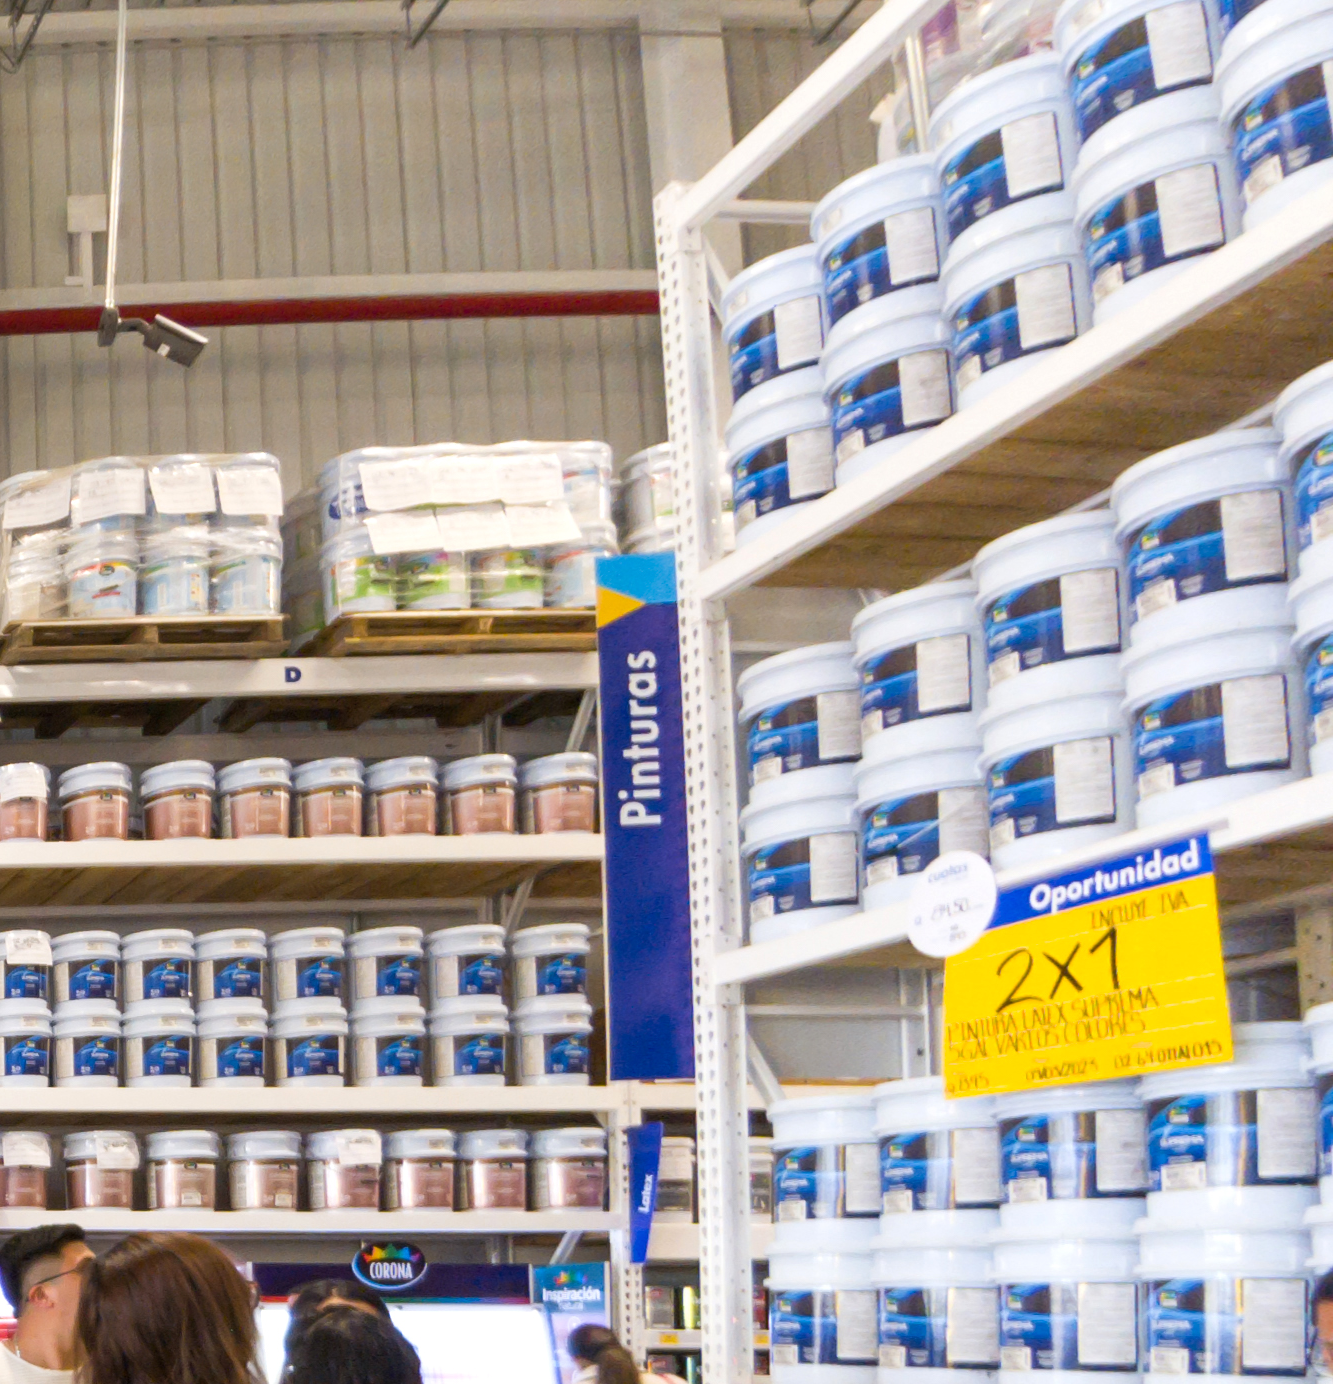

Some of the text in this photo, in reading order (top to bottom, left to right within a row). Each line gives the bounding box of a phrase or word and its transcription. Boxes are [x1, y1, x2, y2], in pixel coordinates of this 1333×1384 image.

[284, 666, 302, 683] D
[619, 650, 662, 826] Pinturas
[1029, 839, 1199, 913] Oportunidad
[1160, 889, 1190, 914] IVA
[638, 1173, 653, 1214] Latex
[369, 1262, 413, 1279] CORONA
[542, 1285, 601, 1303] Inspiración
